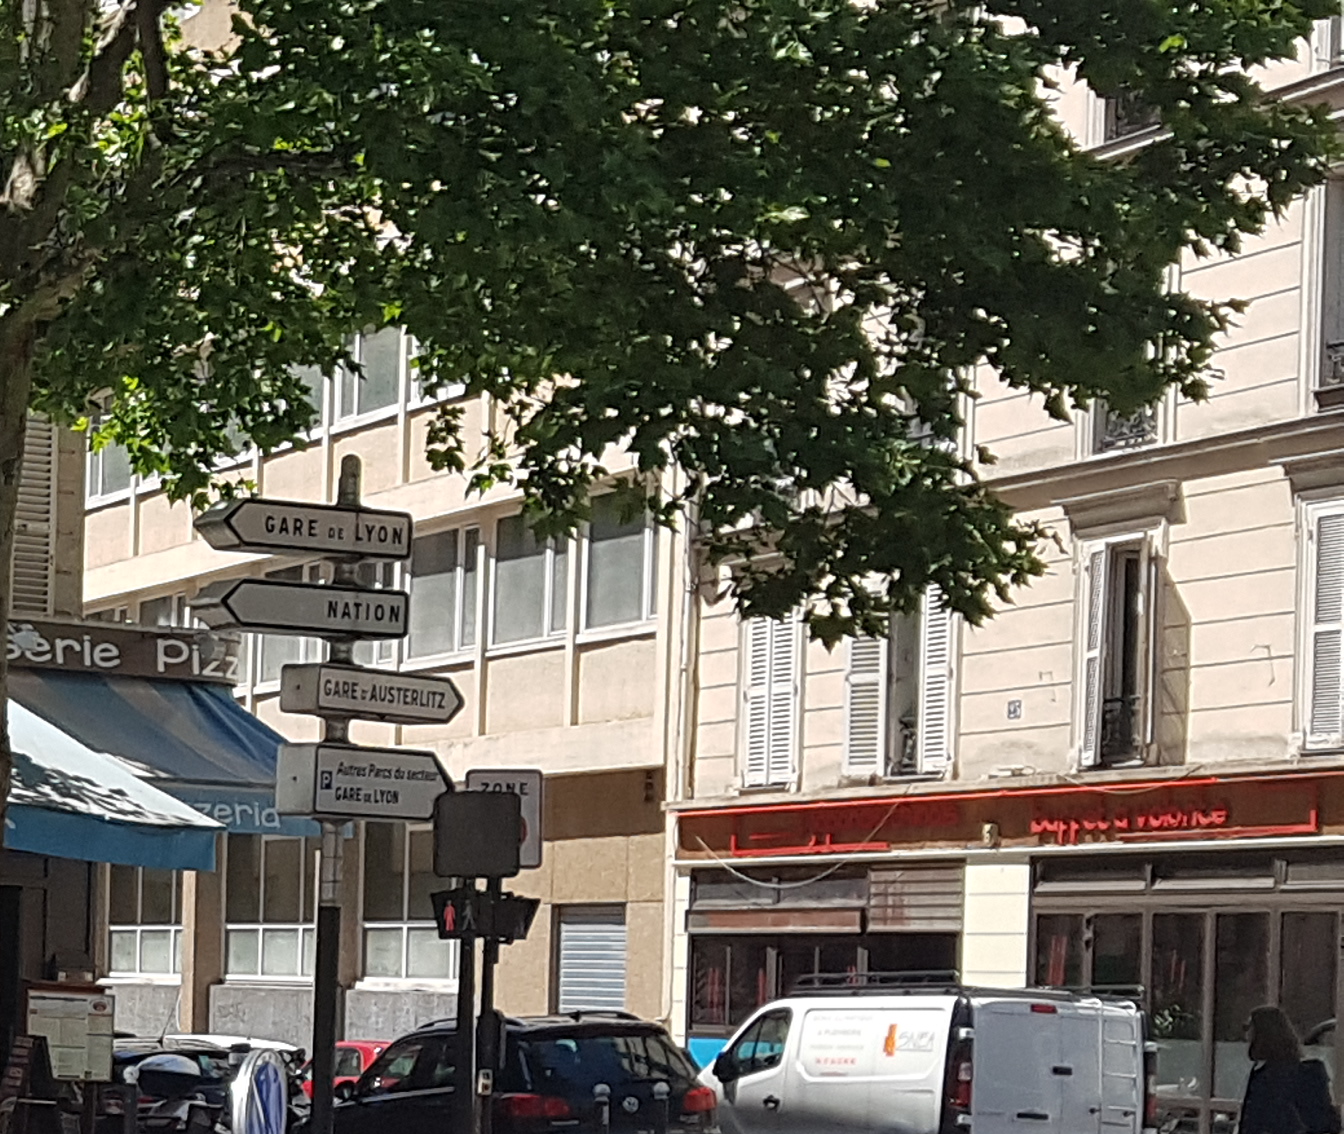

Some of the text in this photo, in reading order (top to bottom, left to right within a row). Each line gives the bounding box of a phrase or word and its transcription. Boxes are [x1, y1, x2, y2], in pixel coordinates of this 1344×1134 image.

[265, 515, 403, 545] GARE DE LYON
[328, 600, 400, 622] NATION
[324, 679, 359, 700] GARE
[336, 761, 367, 777] Autres
[368, 763, 392, 779] Parcs
[335, 786, 362, 802] GARE
[374, 789, 399, 804] LYON
[481, 782, 529, 796] ZONE
